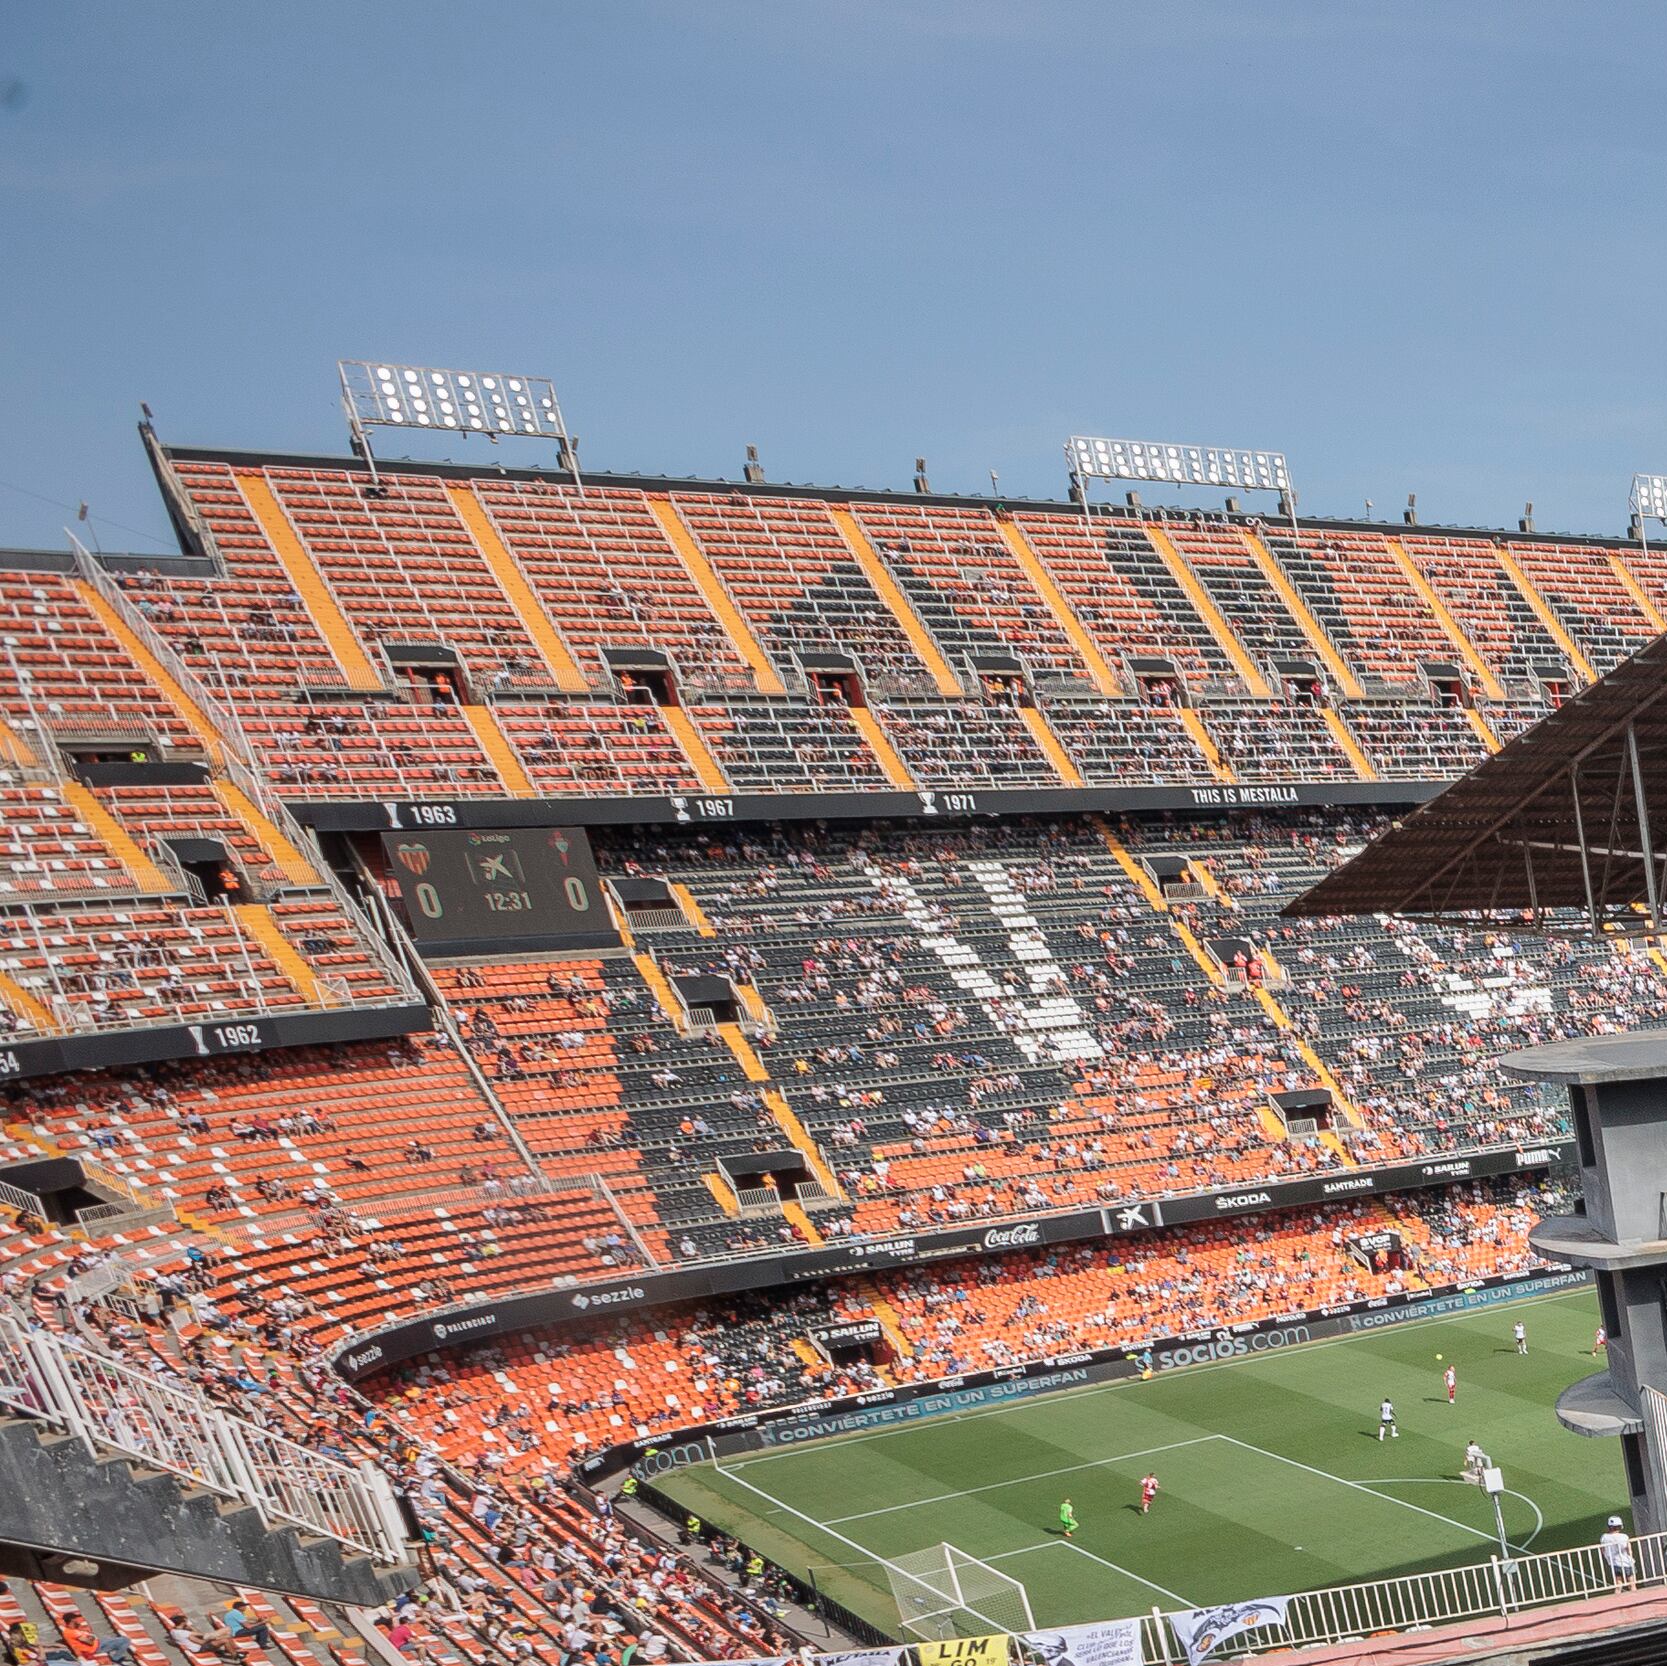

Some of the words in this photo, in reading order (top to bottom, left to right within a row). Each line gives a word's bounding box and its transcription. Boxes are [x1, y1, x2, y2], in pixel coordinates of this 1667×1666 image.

[942, 794, 976, 812] 1971
[1191, 787, 1220, 805] THIS
[1222, 787, 1237, 804] IS
[1239, 786, 1300, 804] MESTALLA
[410, 804, 457, 824] 1963
[695, 799, 735, 818] 1967
[415, 882, 443, 919] 0
[563, 875, 590, 912] 0
[483, 891, 533, 912] 12:31
[213, 1025, 262, 1048] 1962
[1515, 1149, 1551, 1167] PUMA
[1323, 1177, 1374, 1194] SAMTRADE
[1215, 1191, 1272, 1210] ŠKODA
[864, 1239, 915, 1255] SAILUN
[590, 1286, 645, 1306] sezzle
[1467, 1293, 1489, 1306] EN
[1490, 1286, 1513, 1301] UN
[1515, 1271, 1586, 1297] SUPERFAN
[830, 1321, 879, 1340] SAILUN
[356, 1344, 383, 1367] sezzle
[1159, 1324, 1311, 1371] SOCIOS.com
[778, 1403, 921, 1443] CONVIÉRTETE
[922, 1398, 951, 1414] EN
[955, 1391, 985, 1406] UN
[990, 1368, 1089, 1399] SUPERFAN
[938, 1638, 990, 1660] LIM
